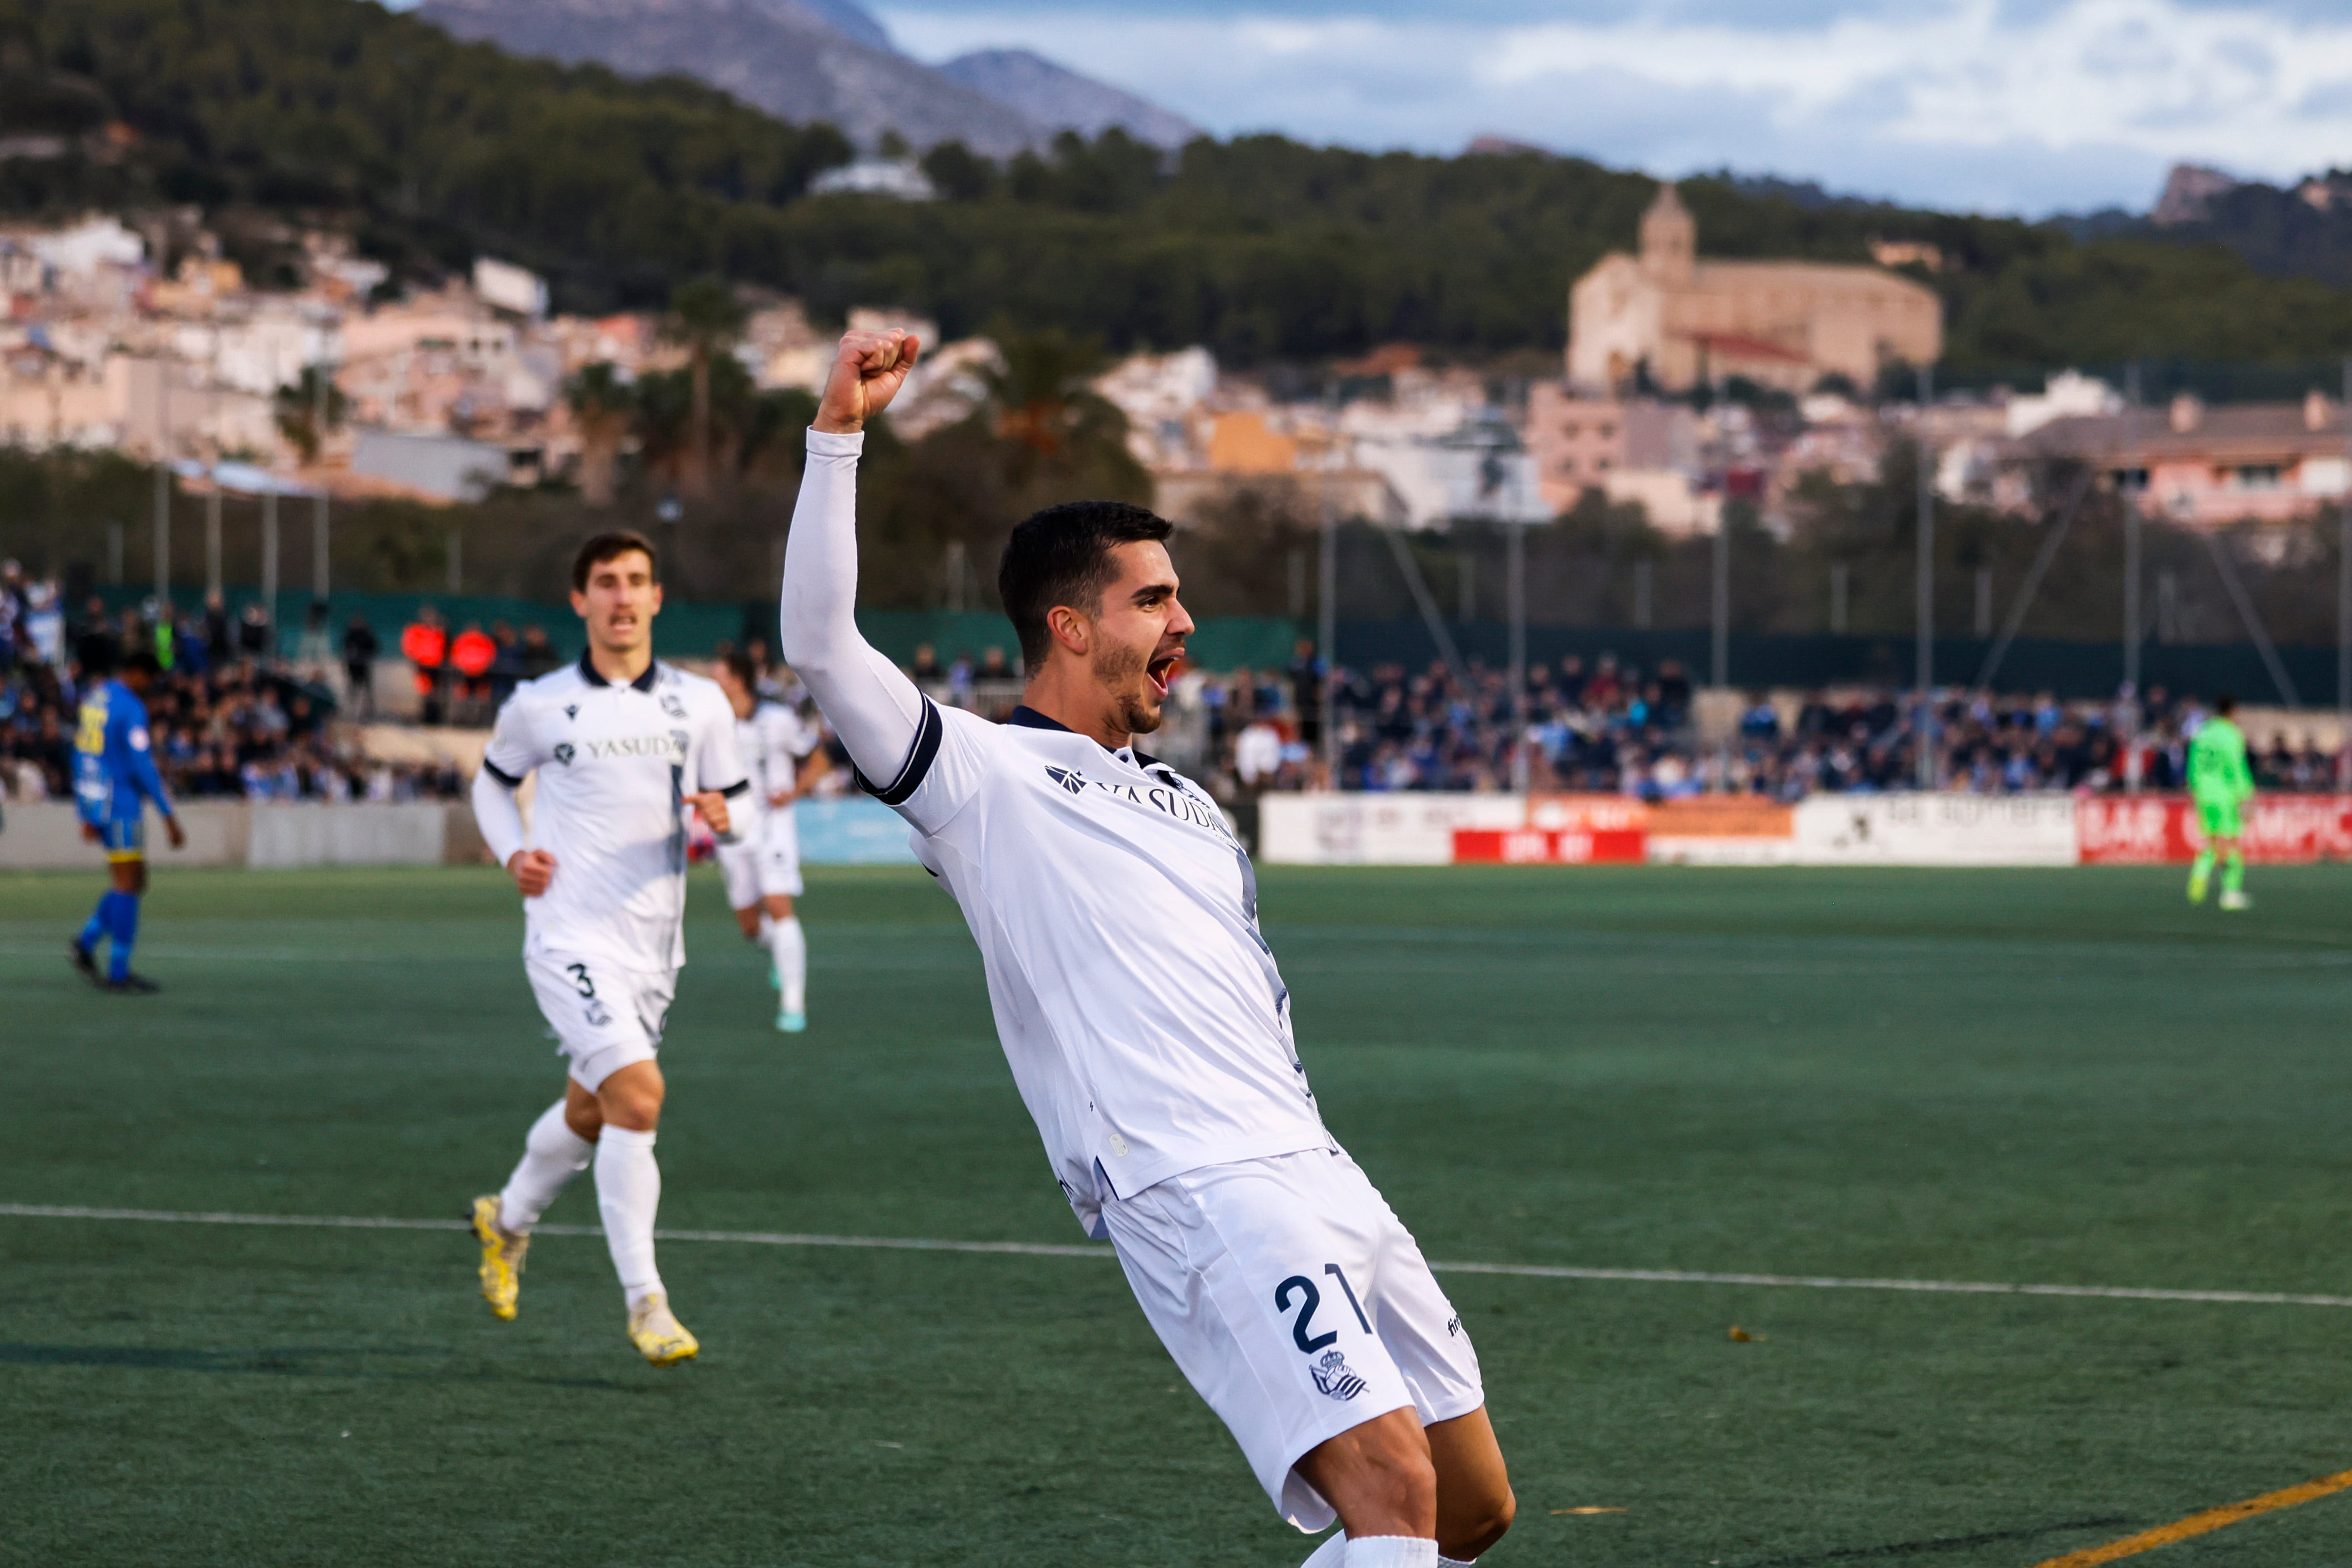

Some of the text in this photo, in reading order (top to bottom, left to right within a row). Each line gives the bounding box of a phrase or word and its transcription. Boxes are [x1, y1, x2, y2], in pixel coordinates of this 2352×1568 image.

[586, 736, 686, 758] YASUDA
[566, 963, 595, 998] 3
[1275, 1263, 1373, 1355] 21
